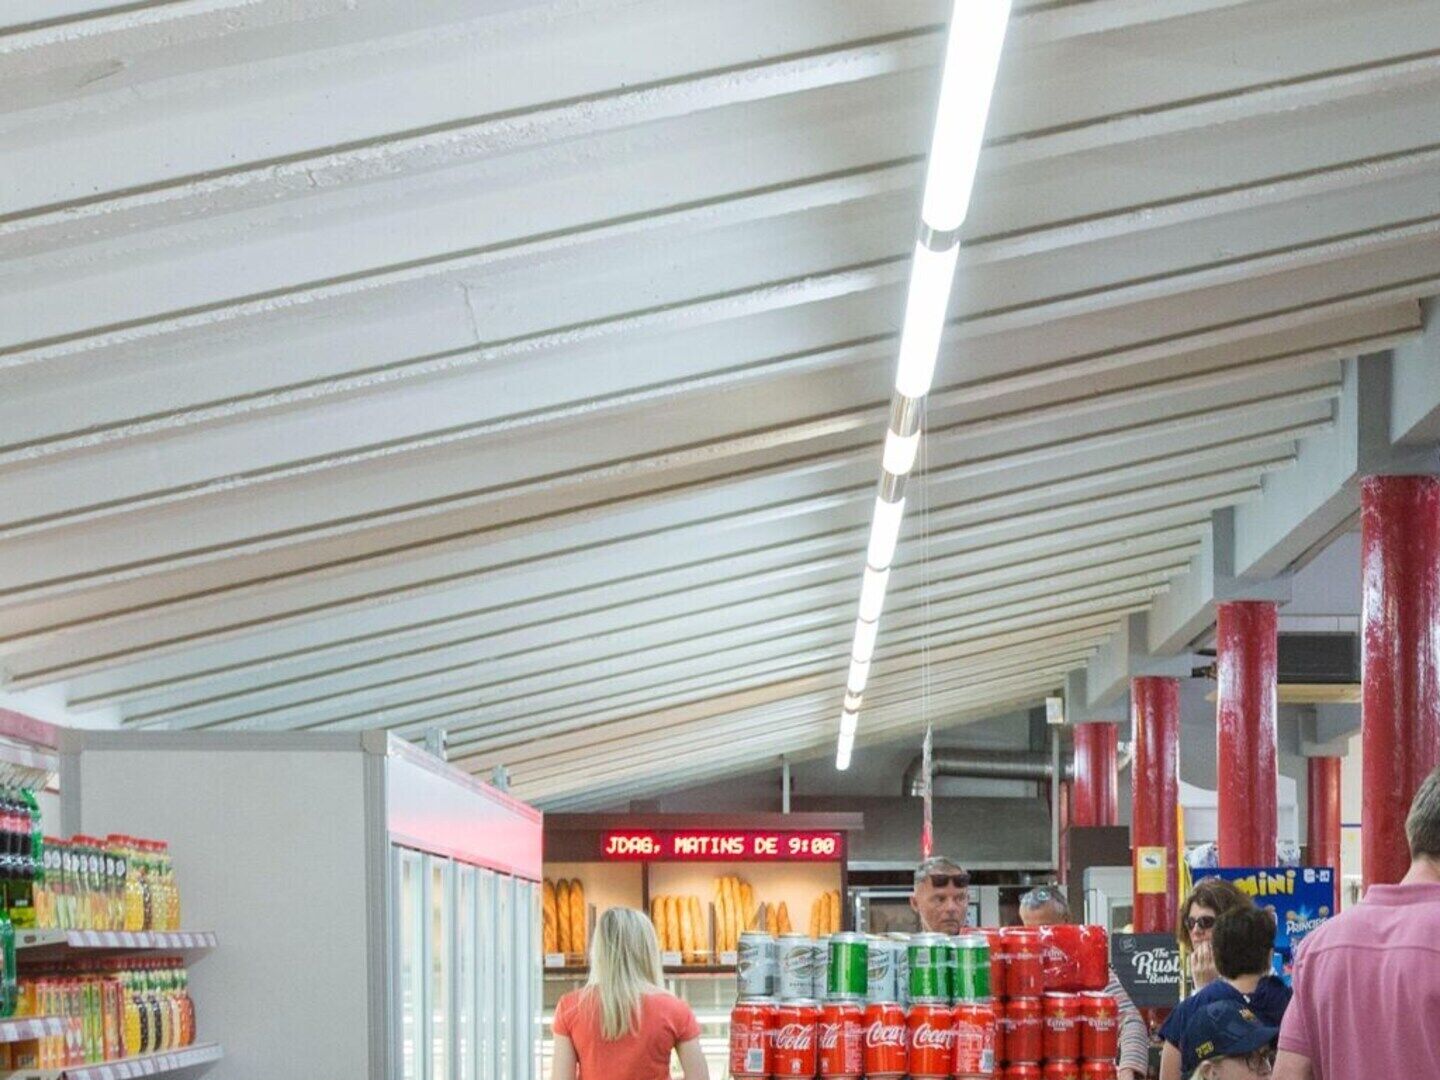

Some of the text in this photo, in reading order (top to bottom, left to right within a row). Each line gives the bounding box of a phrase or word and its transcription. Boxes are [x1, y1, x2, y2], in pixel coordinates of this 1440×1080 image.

[674, 837, 744, 854] MATINS
[753, 837, 778, 854] DE
[788, 837, 835, 854] 9:00
[1153, 948, 1169, 958] The
[1132, 951, 1181, 979] Rust
